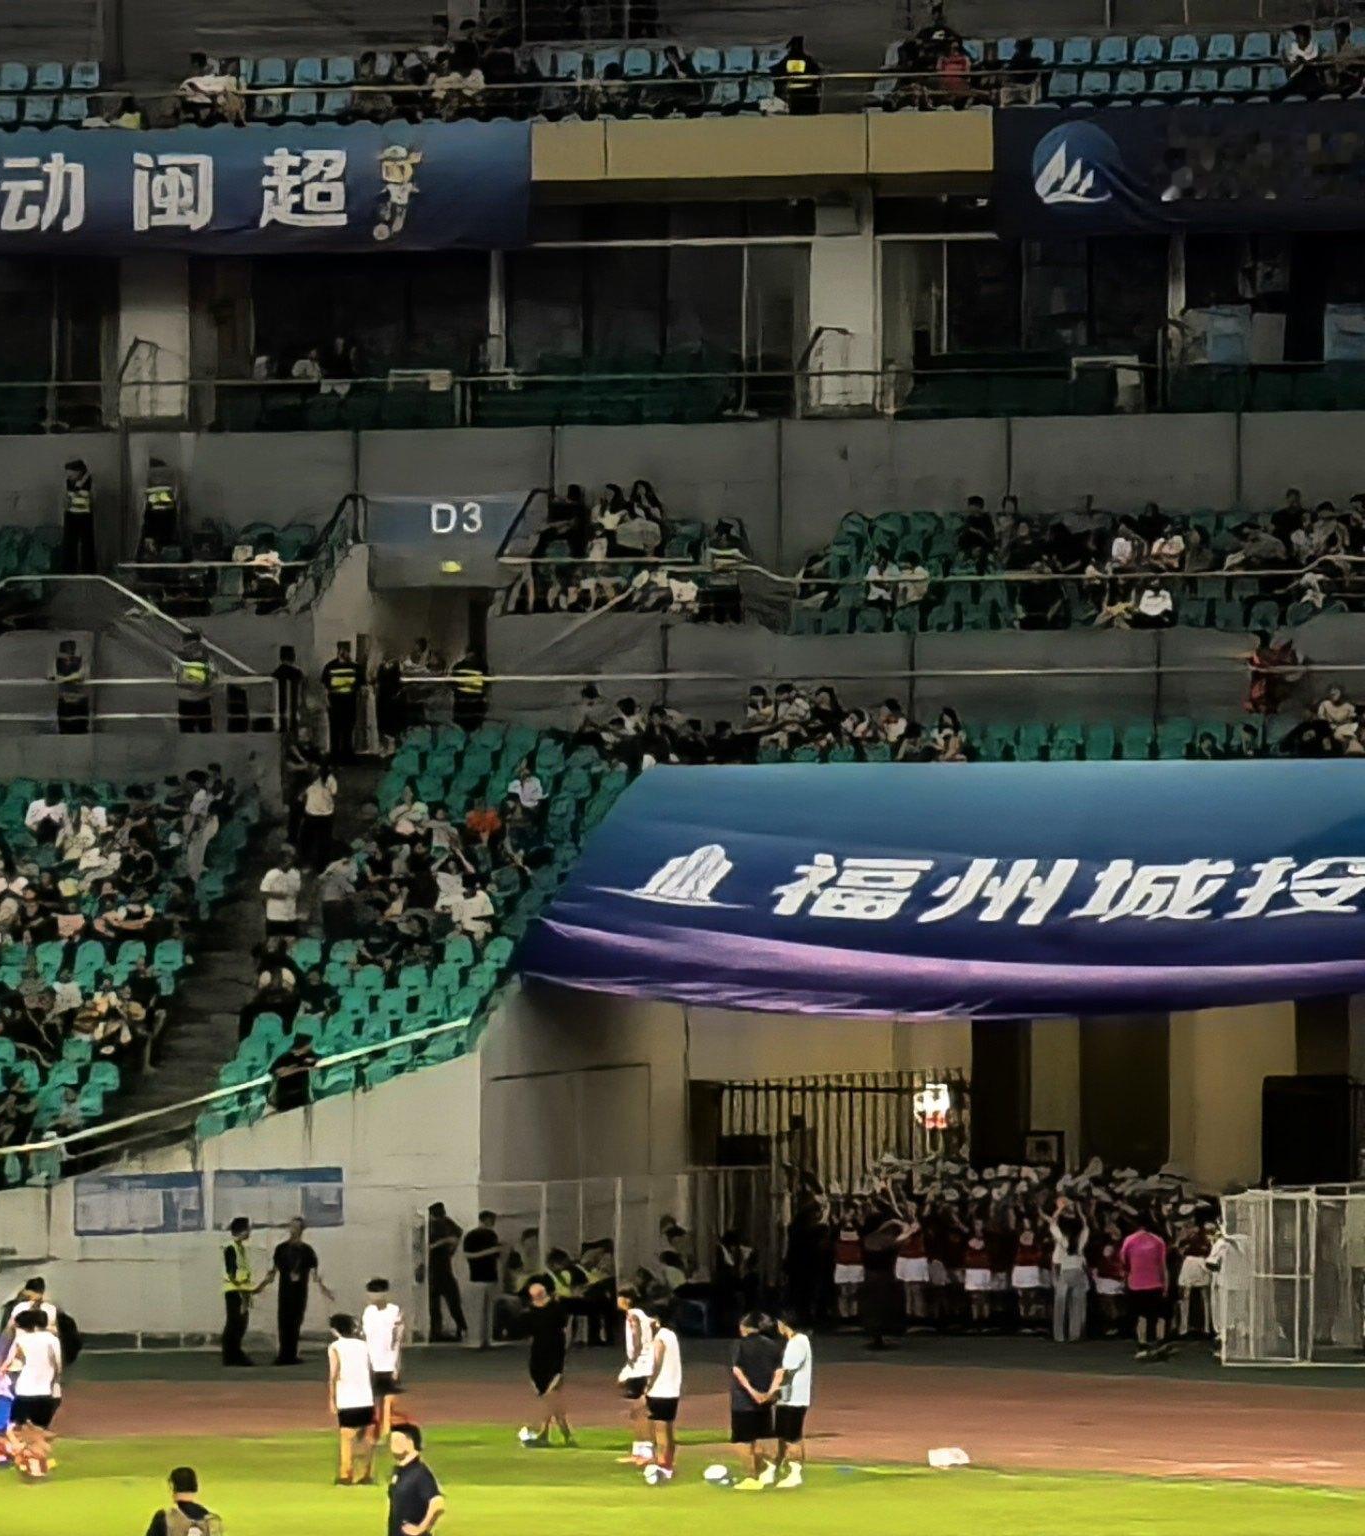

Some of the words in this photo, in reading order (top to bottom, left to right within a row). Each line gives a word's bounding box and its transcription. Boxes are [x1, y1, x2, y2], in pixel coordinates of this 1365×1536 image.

[429, 502, 483, 534] D3
[772, 853, 1365, 926] 福州城投
